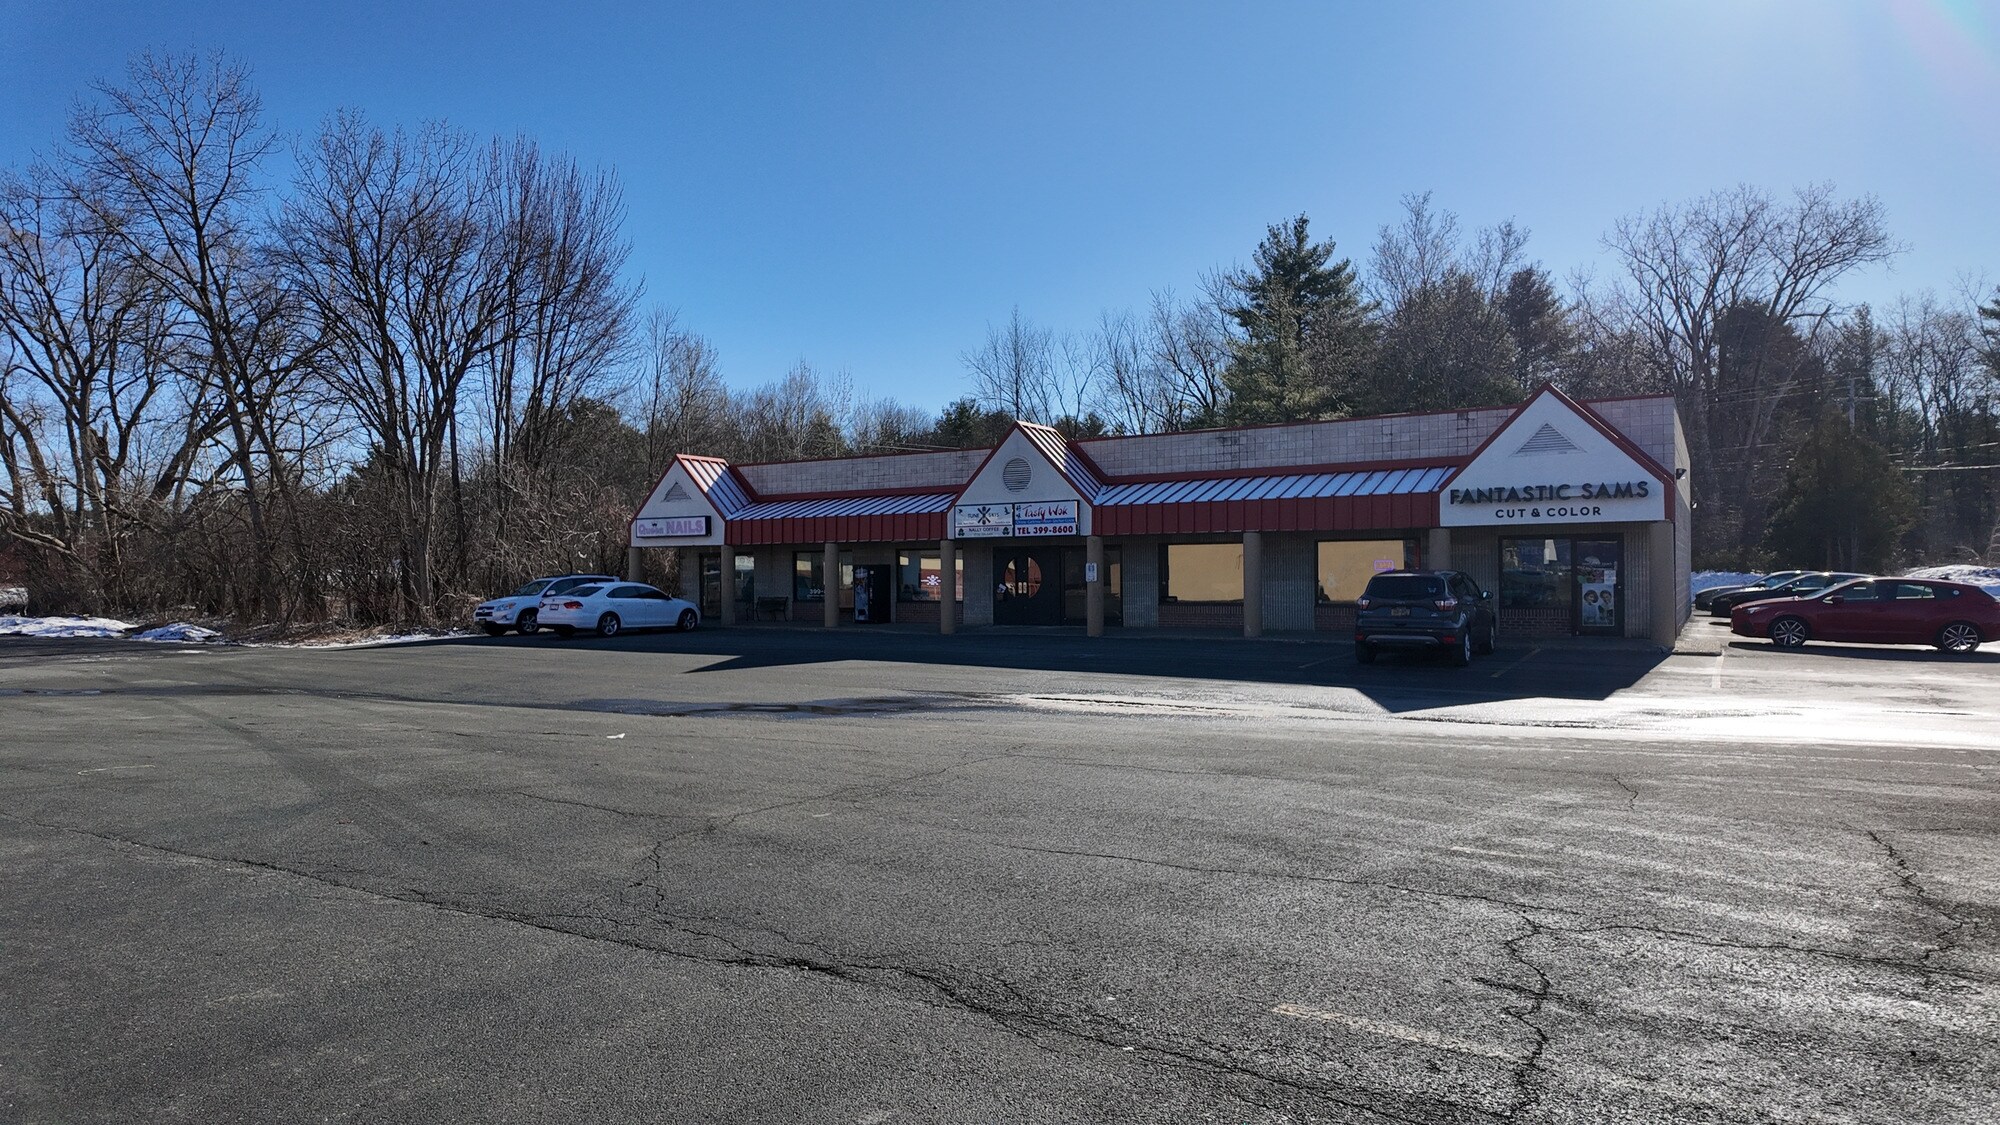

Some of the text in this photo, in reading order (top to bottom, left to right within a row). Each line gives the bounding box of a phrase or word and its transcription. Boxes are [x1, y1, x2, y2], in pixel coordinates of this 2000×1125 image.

[1450, 481, 1649, 504] FANTASTIC SAMS
[1023, 505, 1046, 521] Tasty
[1048, 504, 1068, 516] Wok
[1495, 506, 1601, 518] CUT & COLOR
[638, 520, 703, 535] Queen NAILS
[1017, 525, 1074, 535] TEL 399-8600
